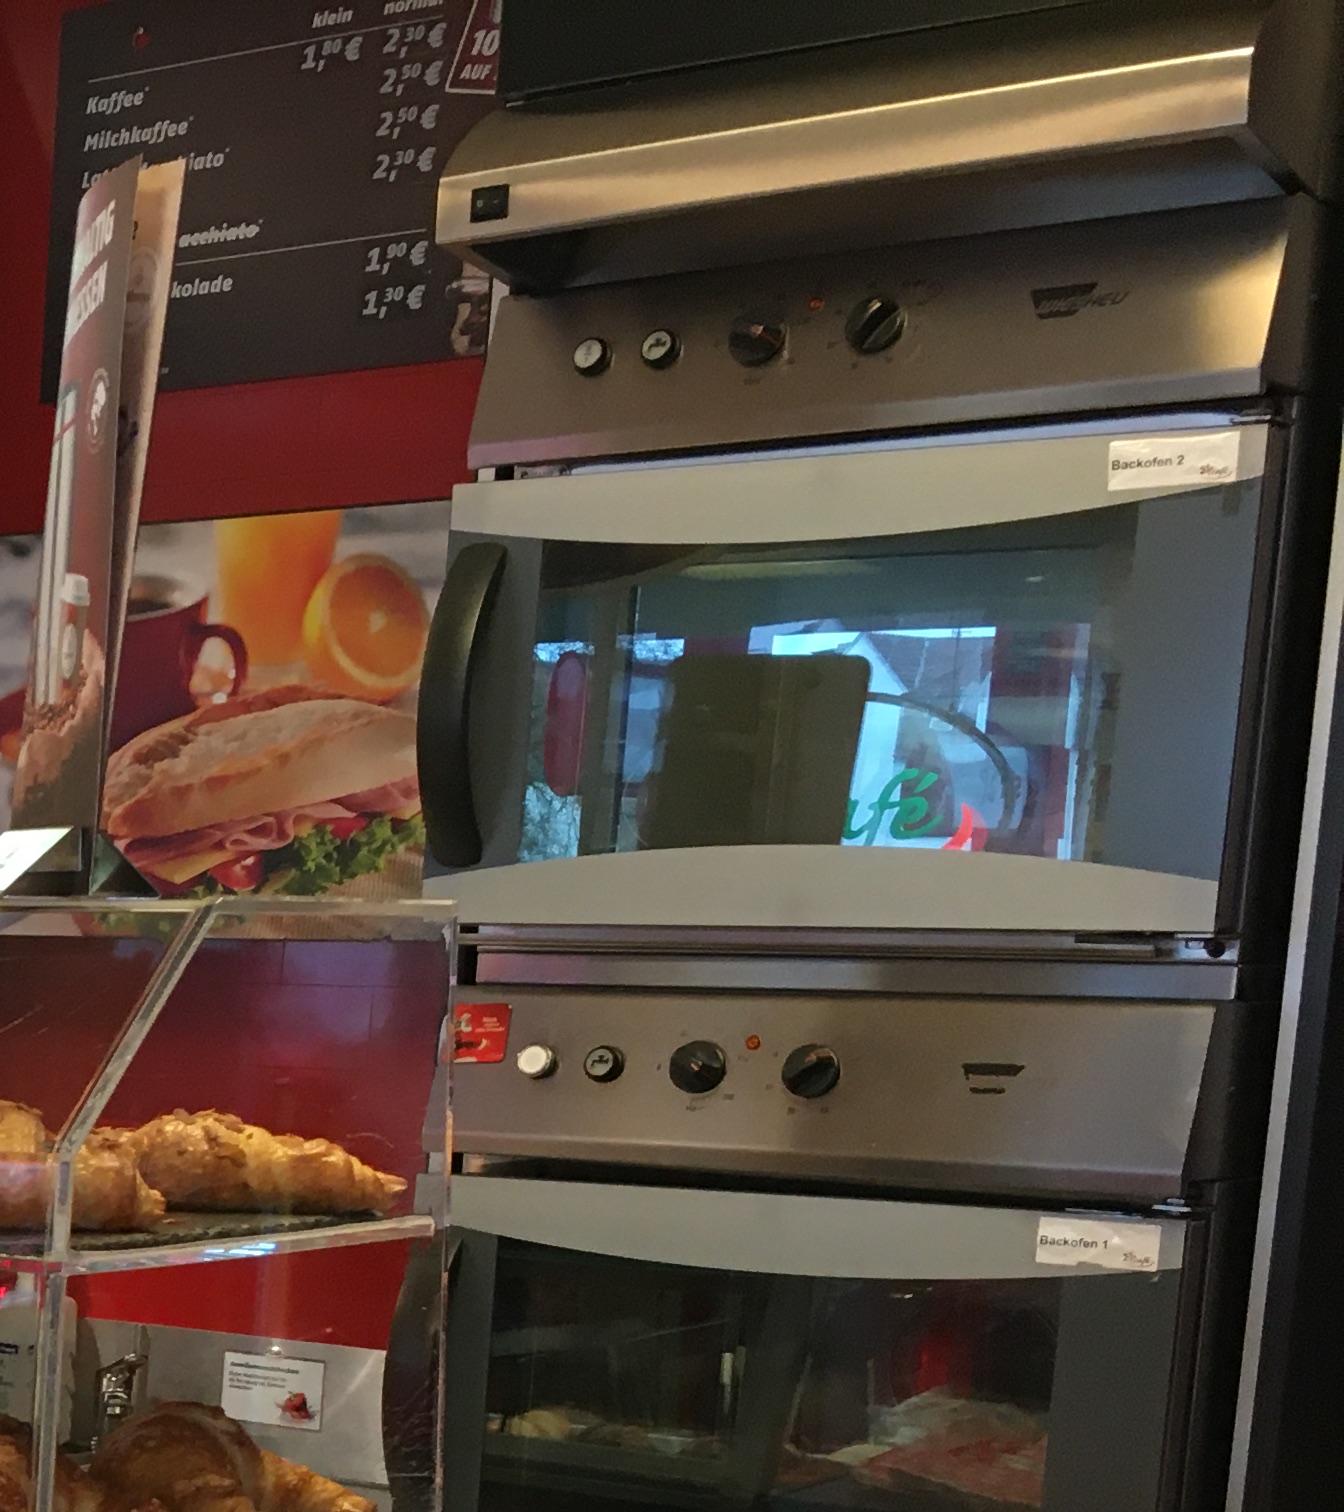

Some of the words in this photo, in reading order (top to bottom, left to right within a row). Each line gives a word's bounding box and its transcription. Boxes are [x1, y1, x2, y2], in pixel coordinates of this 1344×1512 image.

[312, 7, 353, 28] klein
[301, 39, 342, 72] 1,80
[344, 37, 362, 61] €
[383, 25, 425, 58] 2,30
[427, 22, 446, 48] €
[379, 63, 421, 96] 2,50
[424, 60, 443, 86] €
[459, 64, 492, 80] AUF
[376, 106, 418, 139] 2,50
[420, 104, 439, 130] €
[373, 149, 415, 182] 2,30
[417, 147, 433, 171] €
[365, 242, 407, 276] 1,90
[409, 240, 429, 266] €
[171, 275, 233, 299] kolade
[362, 286, 404, 319] 1,30
[406, 284, 425, 310] €
[1111, 456, 1173, 471] Backofen
[1039, 1235, 1098, 1249] Backofen
